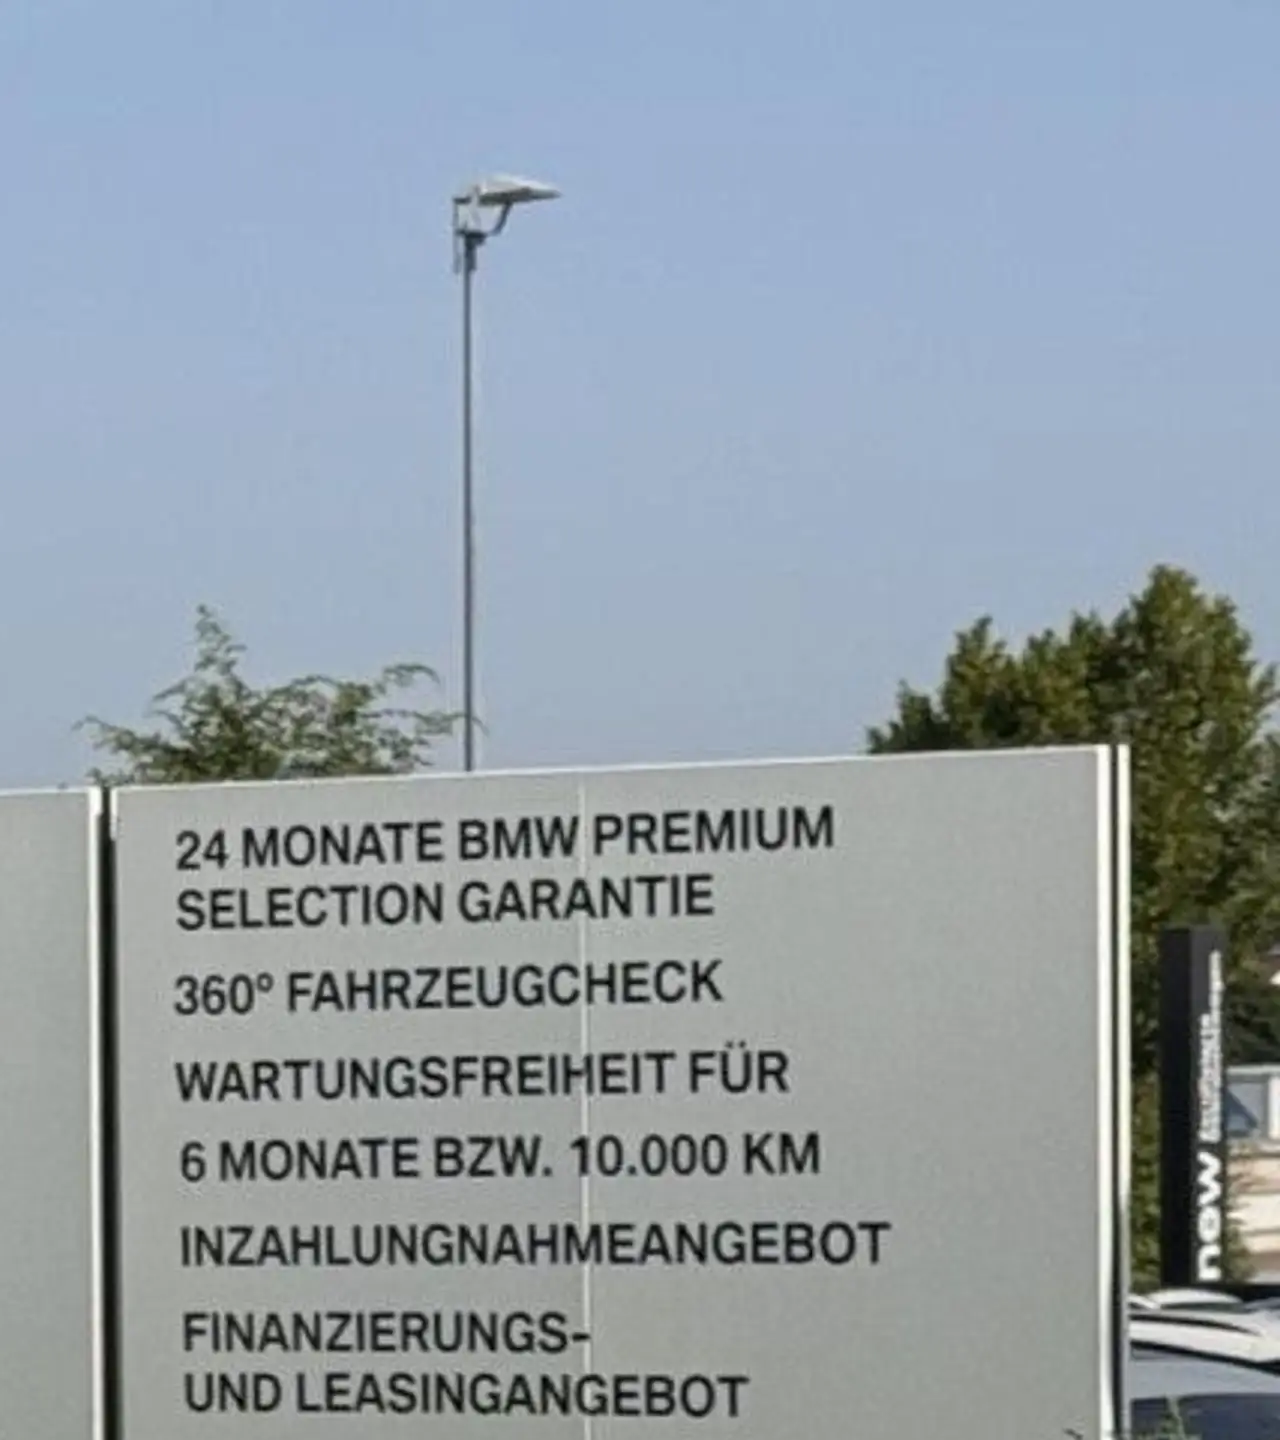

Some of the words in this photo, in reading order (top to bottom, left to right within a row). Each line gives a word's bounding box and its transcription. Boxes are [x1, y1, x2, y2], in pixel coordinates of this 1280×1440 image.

[176, 829, 228, 870] 24
[242, 821, 444, 868] MONATE
[459, 815, 580, 861] BMW
[593, 805, 834, 855] PREMIUM
[176, 882, 444, 931] SELECTION
[458, 874, 714, 922] GARANTIE
[288, 960, 723, 1011] FAHRZEUGCHECK
[175, 1051, 676, 1101] WARTUNGSFREIHEIT
[689, 1041, 790, 1093] FÜR
[181, 1141, 206, 1182] 6
[220, 1137, 419, 1180] MONATE
[434, 1136, 552, 1177] BZW.
[570, 1133, 728, 1176] 10.000
[744, 1132, 821, 1175] KM
[181, 1221, 892, 1267] INZAHLUNGNAHMEANGEBOT
[183, 1310, 592, 1355] FINANZIERUNGS-
[185, 1373, 282, 1415] UND
[296, 1373, 751, 1419] LEASINGANGEBOT
